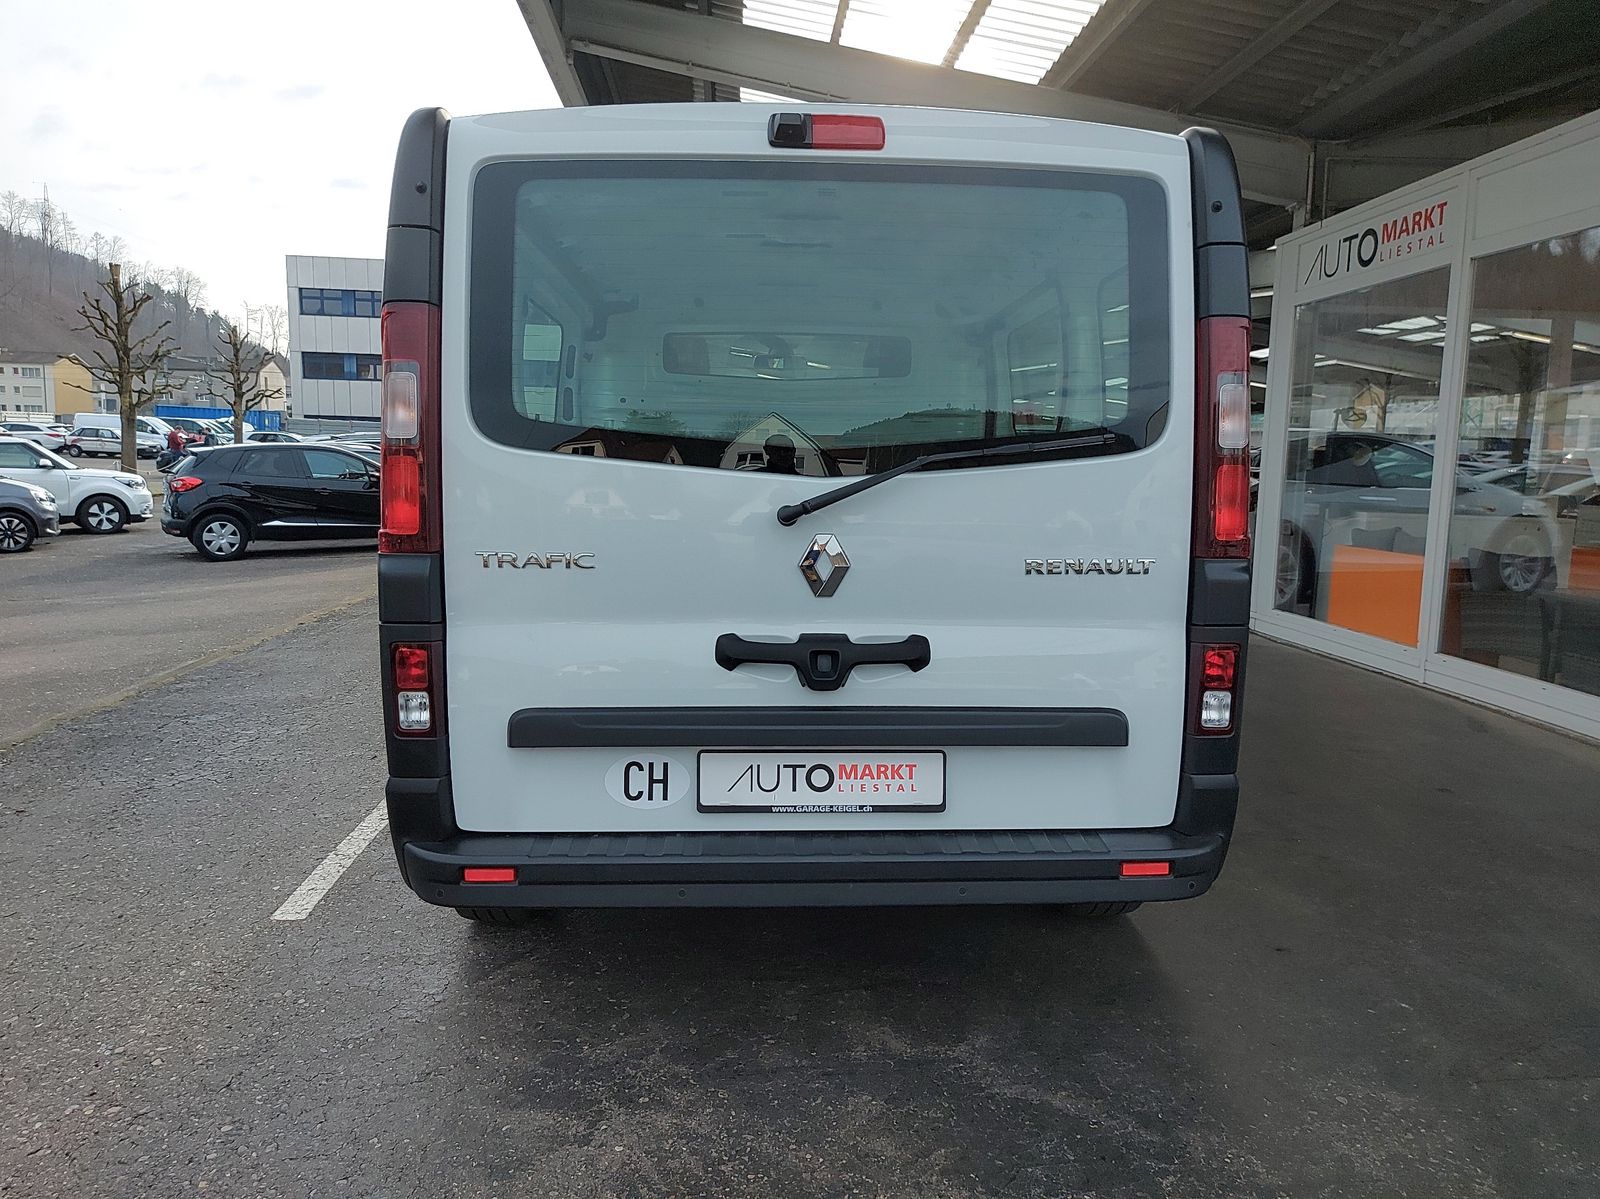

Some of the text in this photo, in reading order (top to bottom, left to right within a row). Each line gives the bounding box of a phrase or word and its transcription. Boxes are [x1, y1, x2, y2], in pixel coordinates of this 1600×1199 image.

[1304, 201, 1449, 285] AUTO MARKT
[1380, 232, 1446, 262] LIESTAL
[475, 551, 596, 569] TRAFIC
[1024, 558, 1156, 575] RENAULT
[623, 761, 669, 801] CH
[727, 763, 917, 793] AUTO MARKT
[838, 783, 917, 793] LIESTAL
[771, 805, 873, 813] www.GARAGE-KEIGEL.ch
